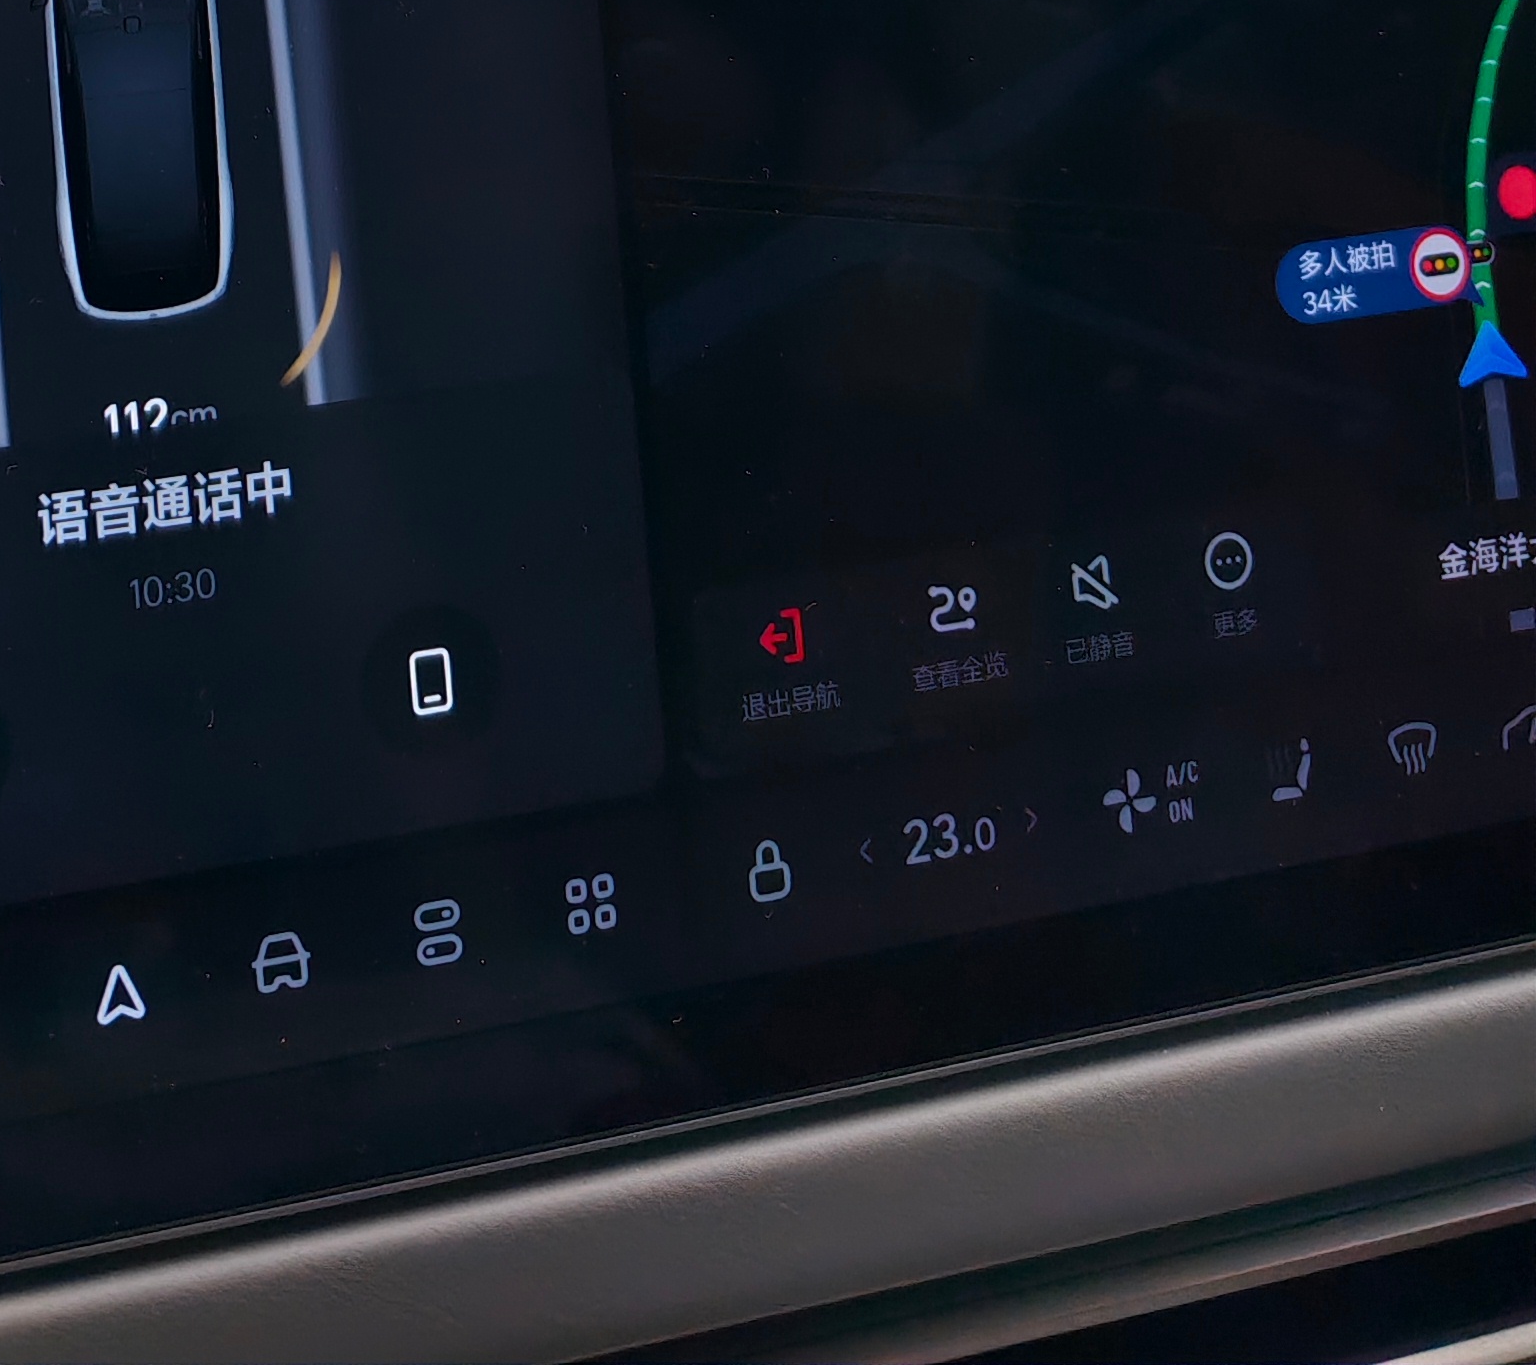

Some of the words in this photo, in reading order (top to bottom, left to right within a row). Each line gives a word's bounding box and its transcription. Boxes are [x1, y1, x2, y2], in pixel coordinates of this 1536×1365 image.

[1298, 240, 1396, 281] 多人被拍
[1302, 283, 1358, 316] 34米
[37, 460, 293, 546] 语音通话中
[1438, 531, 1536, 580] 金海洋
[128, 568, 217, 610] 10:30
[1213, 607, 1259, 639] 更多
[1065, 630, 1135, 665] 已静音
[912, 650, 1010, 693] 查看全览
[741, 680, 841, 723] 退出导航
[1166, 760, 1200, 788] A/C
[1168, 797, 1194, 824] ON
[902, 813, 997, 866] 23.0
